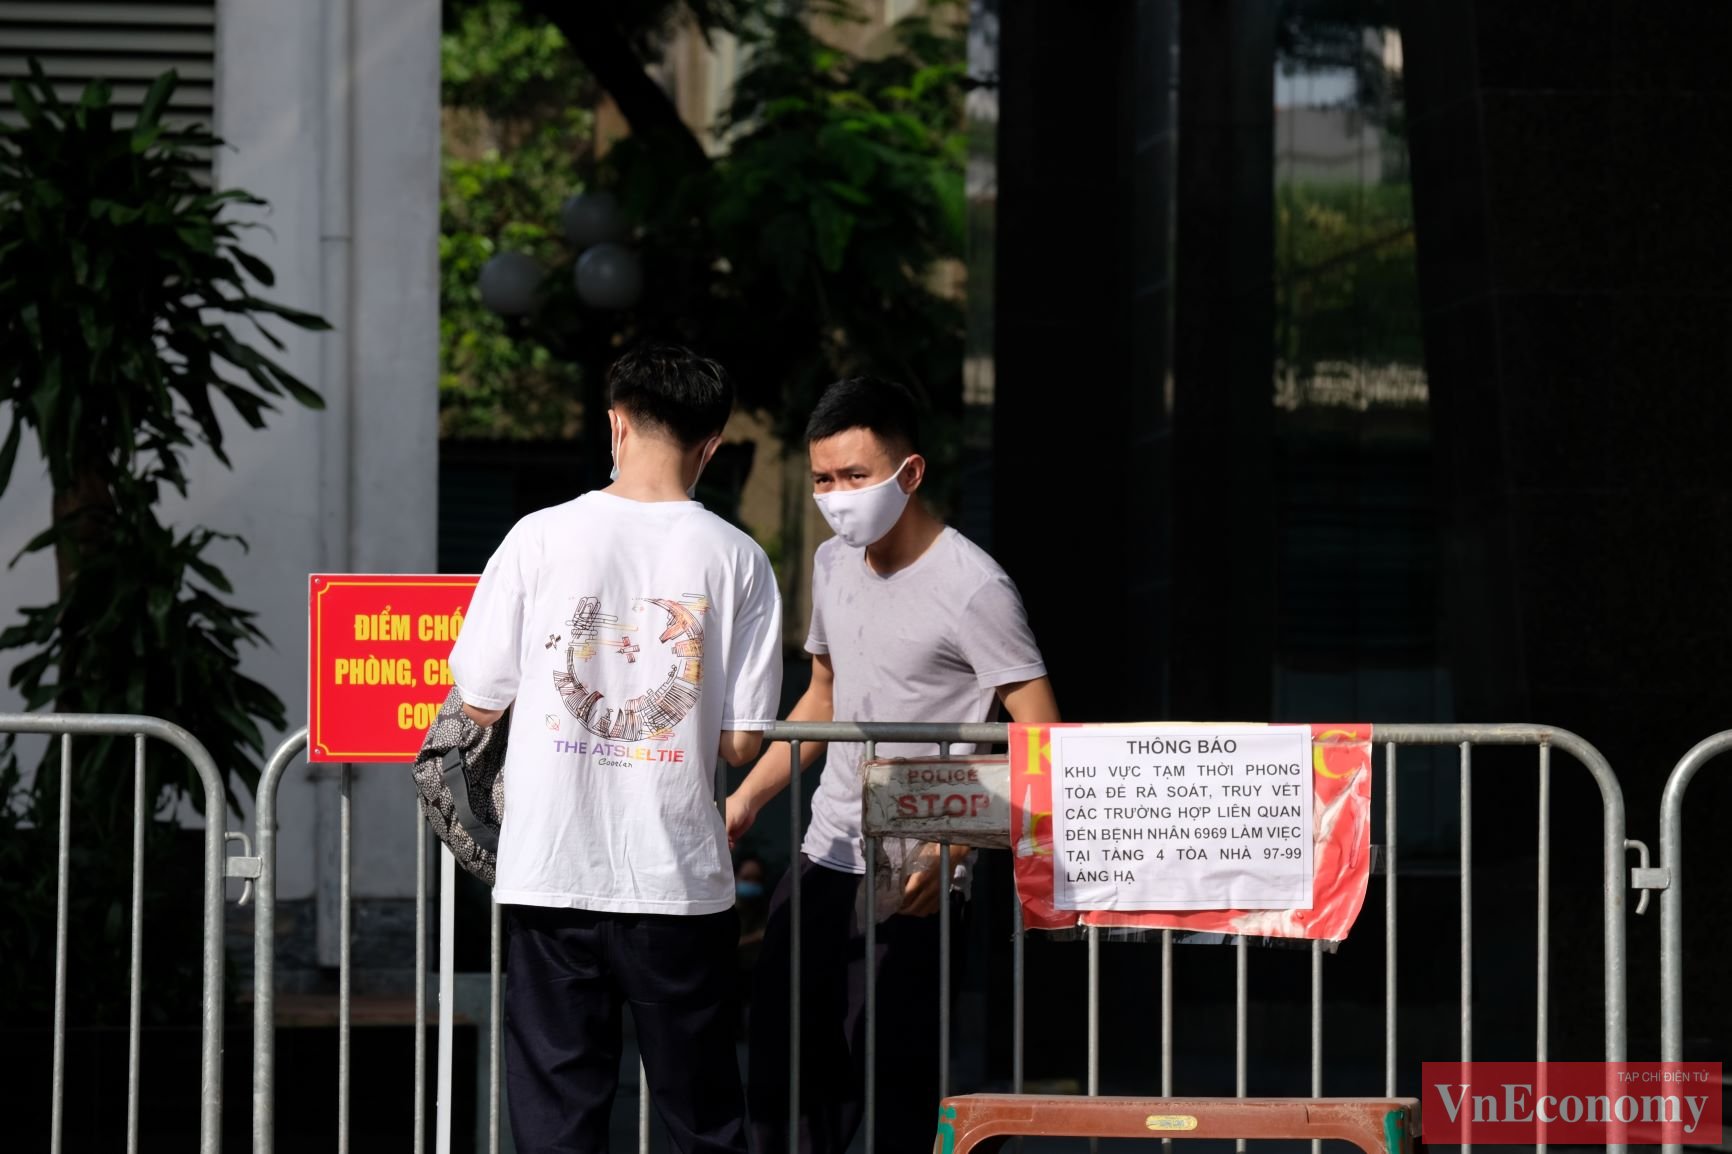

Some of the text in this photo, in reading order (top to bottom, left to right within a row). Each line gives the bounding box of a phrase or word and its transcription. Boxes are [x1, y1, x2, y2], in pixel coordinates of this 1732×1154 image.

[354, 605, 411, 641] ĐIỂM
[335, 654, 417, 687] PHÒNG,
[553, 740, 685, 763] THE ATSLELTIE
[1126, 736, 1237, 754] THÔNG BÁO
[907, 769, 978, 783] POLICE
[1064, 762, 1300, 780] KHU VỰC TẠM THỜI PHONG
[1167, 783, 1212, 799] SOÁT,
[1222, 785, 1262, 797] TRUY
[897, 793, 990, 818] STOP
[1065, 803, 1301, 821] CÁC TRƯỜNG HỢP LIÊN QUAN
[1147, 825, 1190, 840] NHÂN
[1194, 828, 1227, 839] 6969
[1231, 824, 1263, 839] LÀM
[1066, 849, 1090, 865] TẠI
[1156, 849, 1165, 861] 4
[1220, 845, 1252, 860] NHÀ
[1263, 847, 1302, 860] 97-99
[1066, 868, 1135, 885] LÁNG HẠ
